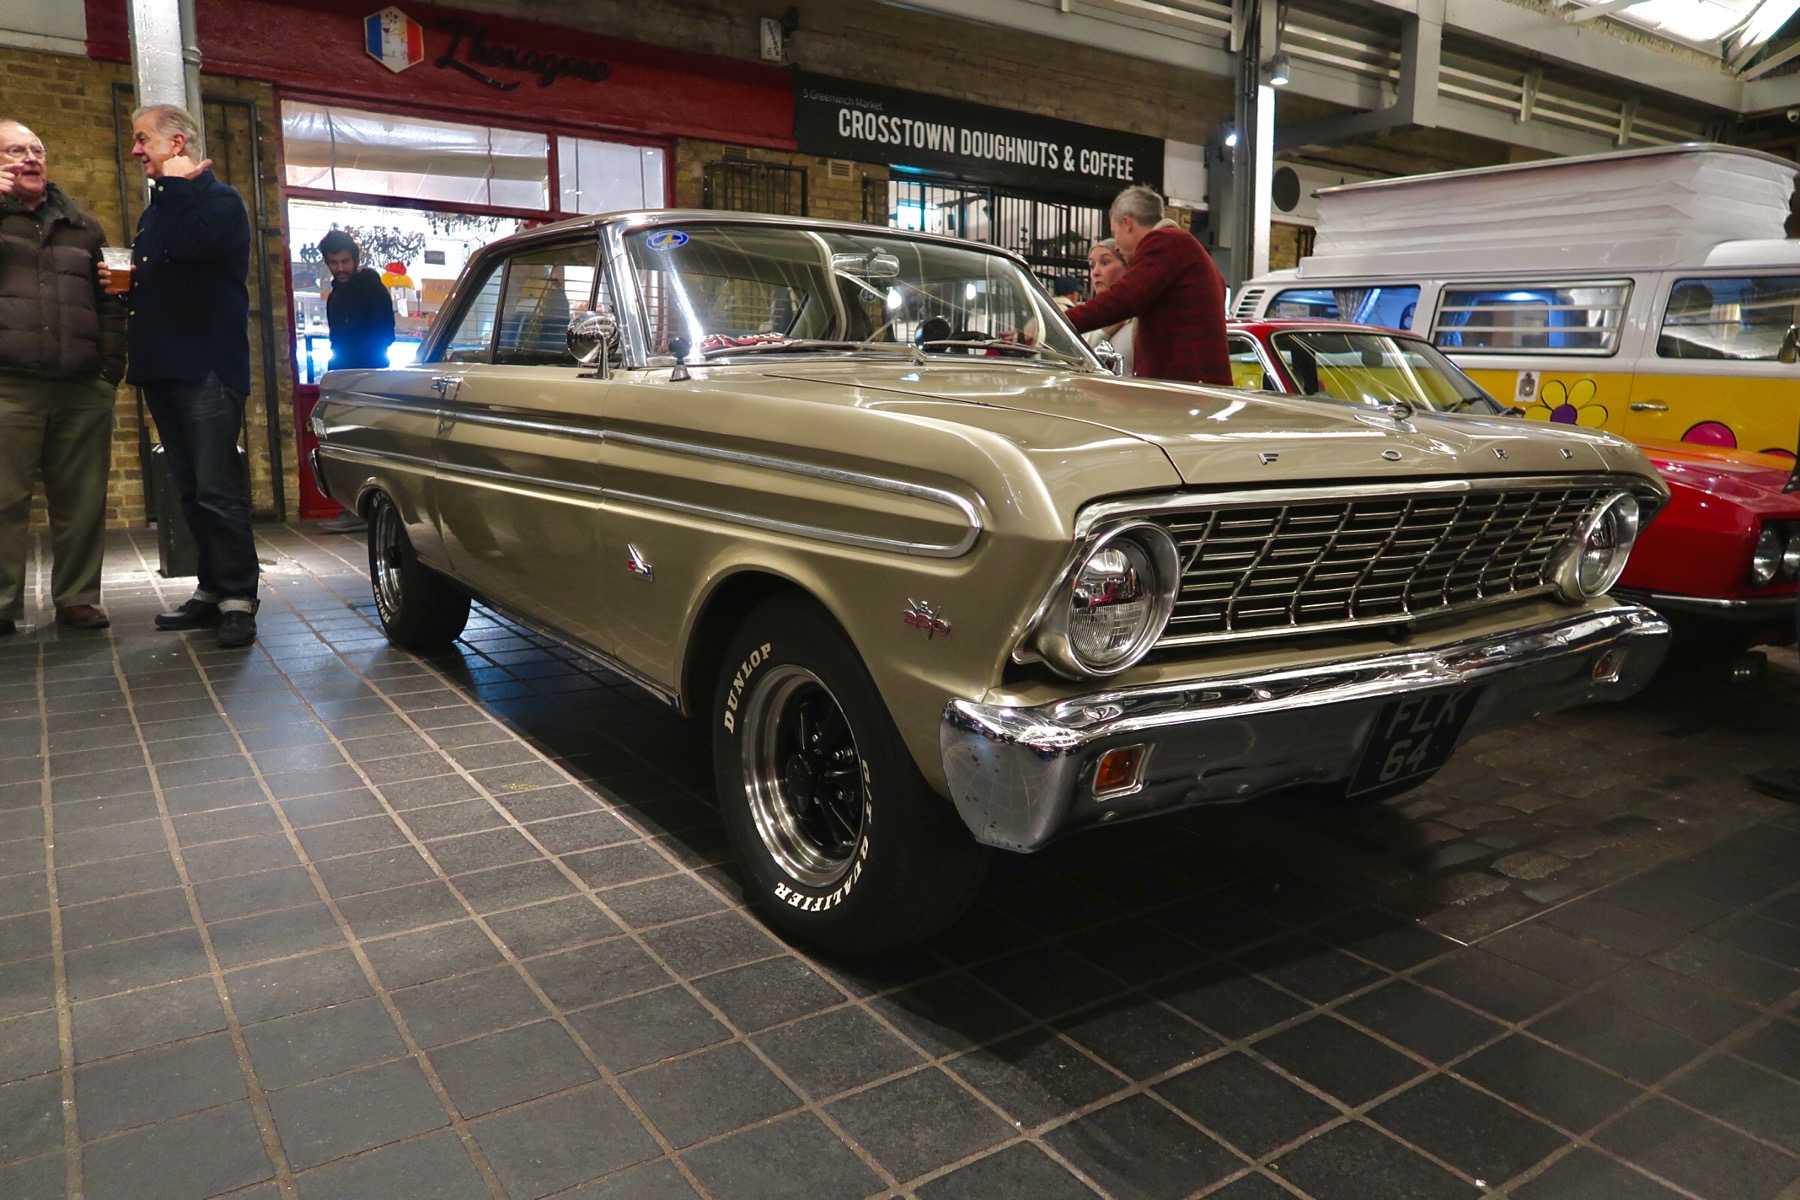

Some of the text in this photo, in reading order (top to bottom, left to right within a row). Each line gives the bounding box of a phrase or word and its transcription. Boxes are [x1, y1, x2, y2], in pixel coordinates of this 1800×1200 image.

[810, 89, 855, 106] Greenwich
[856, 98, 884, 111] Market
[838, 108, 1134, 181] CROSSTOWN DOUGHNUTS & COFFEE
[902, 609, 951, 634] 260
[724, 642, 771, 733] DUNLOP
[1384, 689, 1469, 739] FLK
[1380, 732, 1434, 781] 64
[774, 835, 869, 912] QUALIFIER
